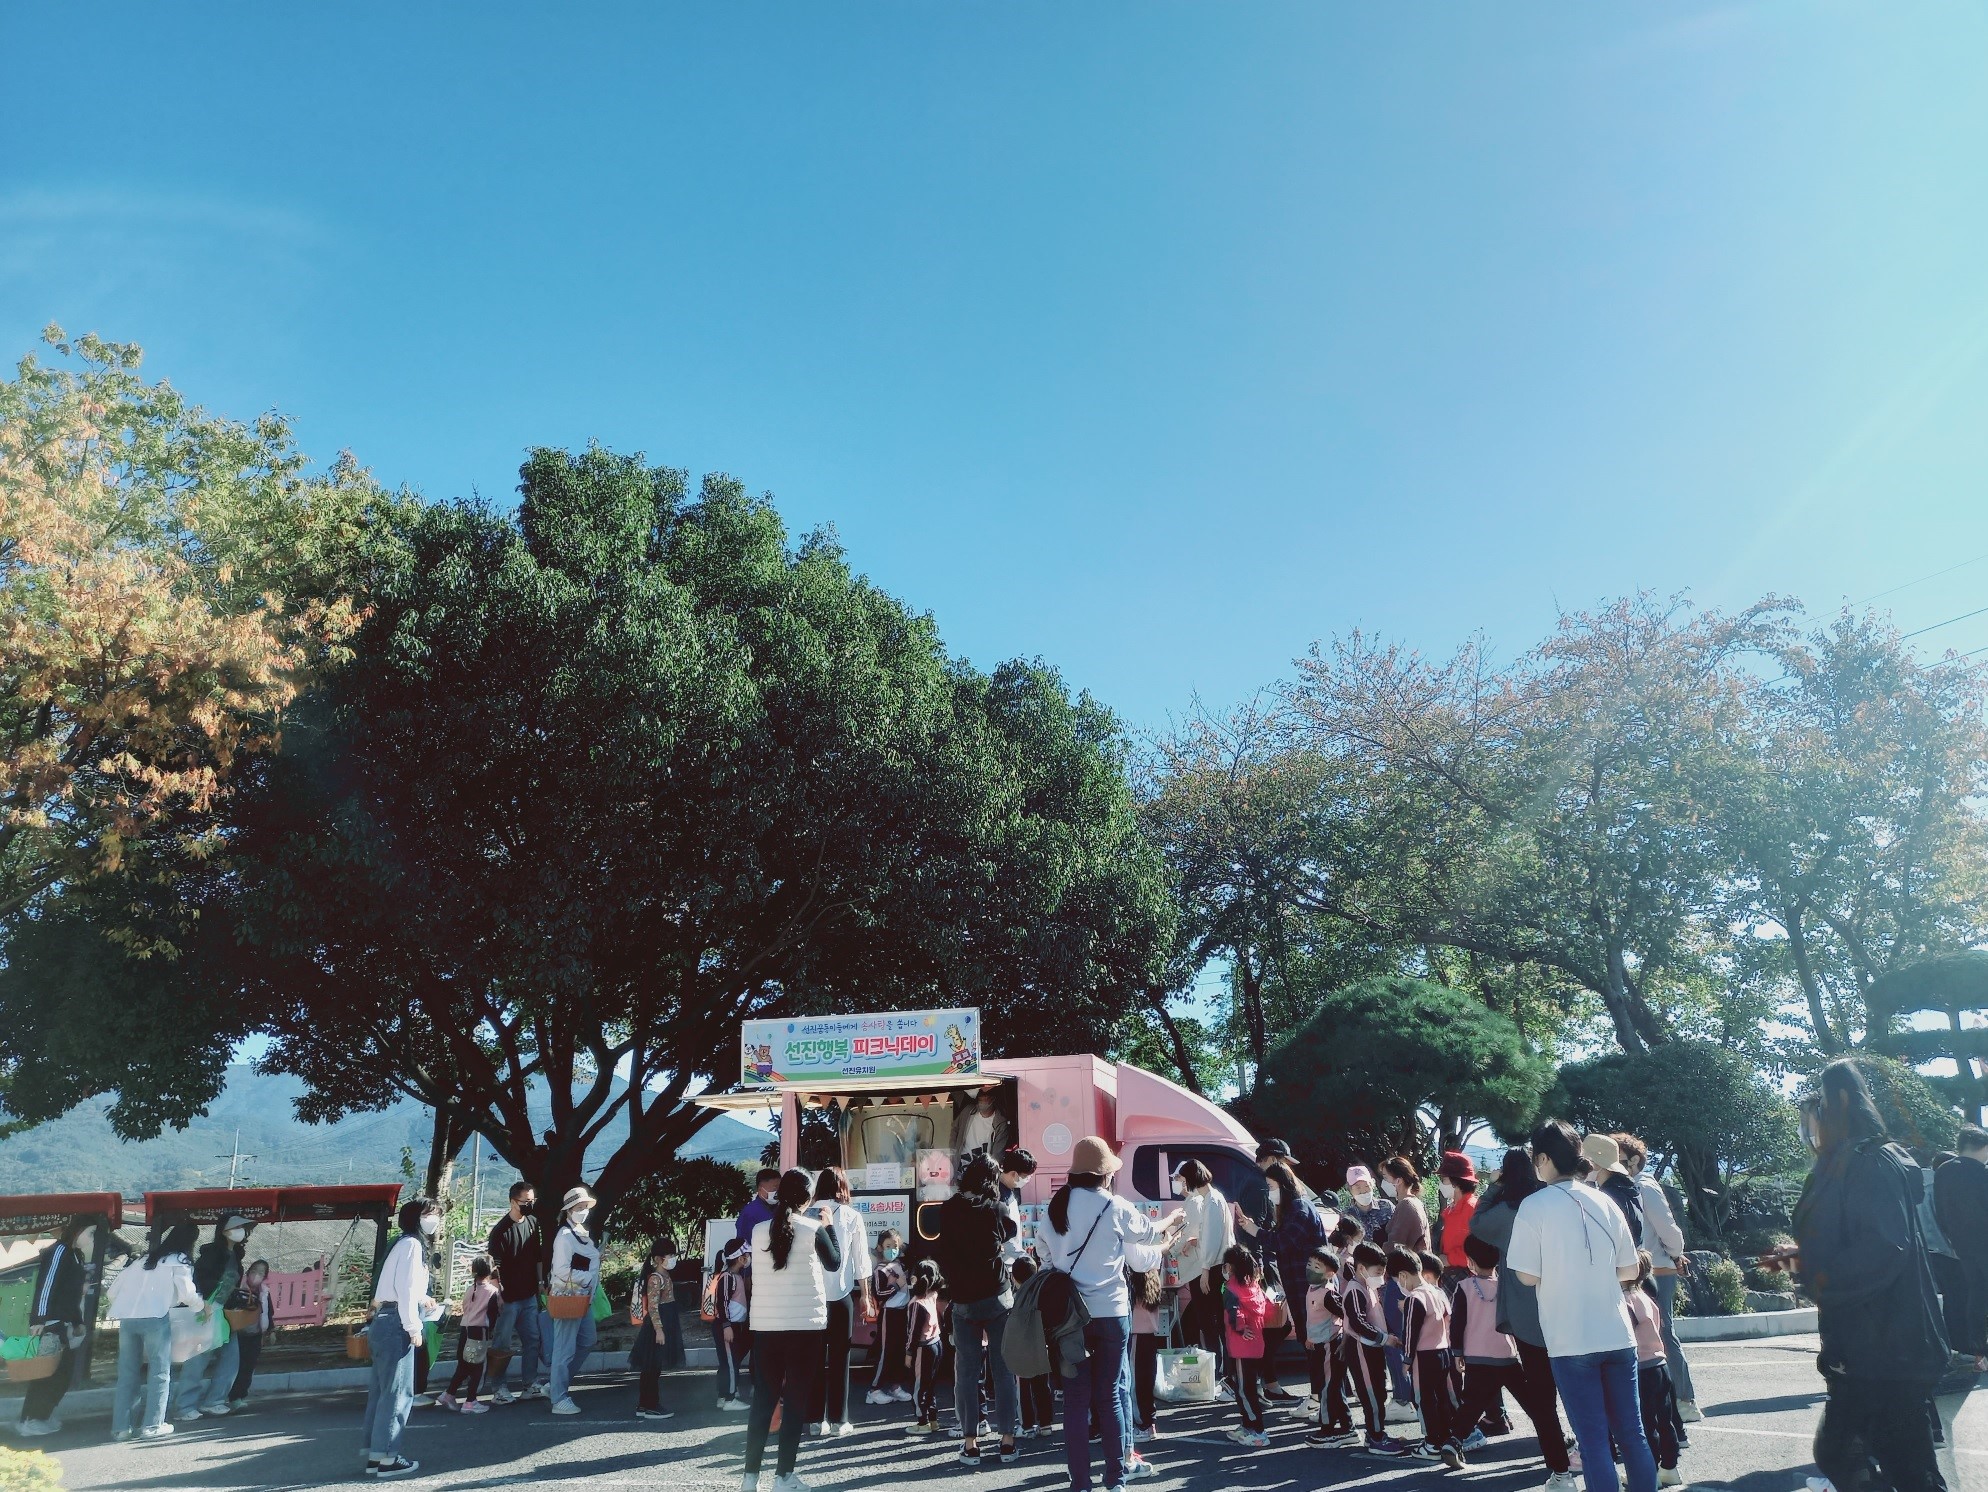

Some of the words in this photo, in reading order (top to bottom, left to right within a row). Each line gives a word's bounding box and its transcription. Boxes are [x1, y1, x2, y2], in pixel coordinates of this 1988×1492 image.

[785, 1039, 849, 1061] 선진행복
[853, 1035, 933, 1055] 피크닉데이
[842, 1066, 875, 1074] 선진유치원
